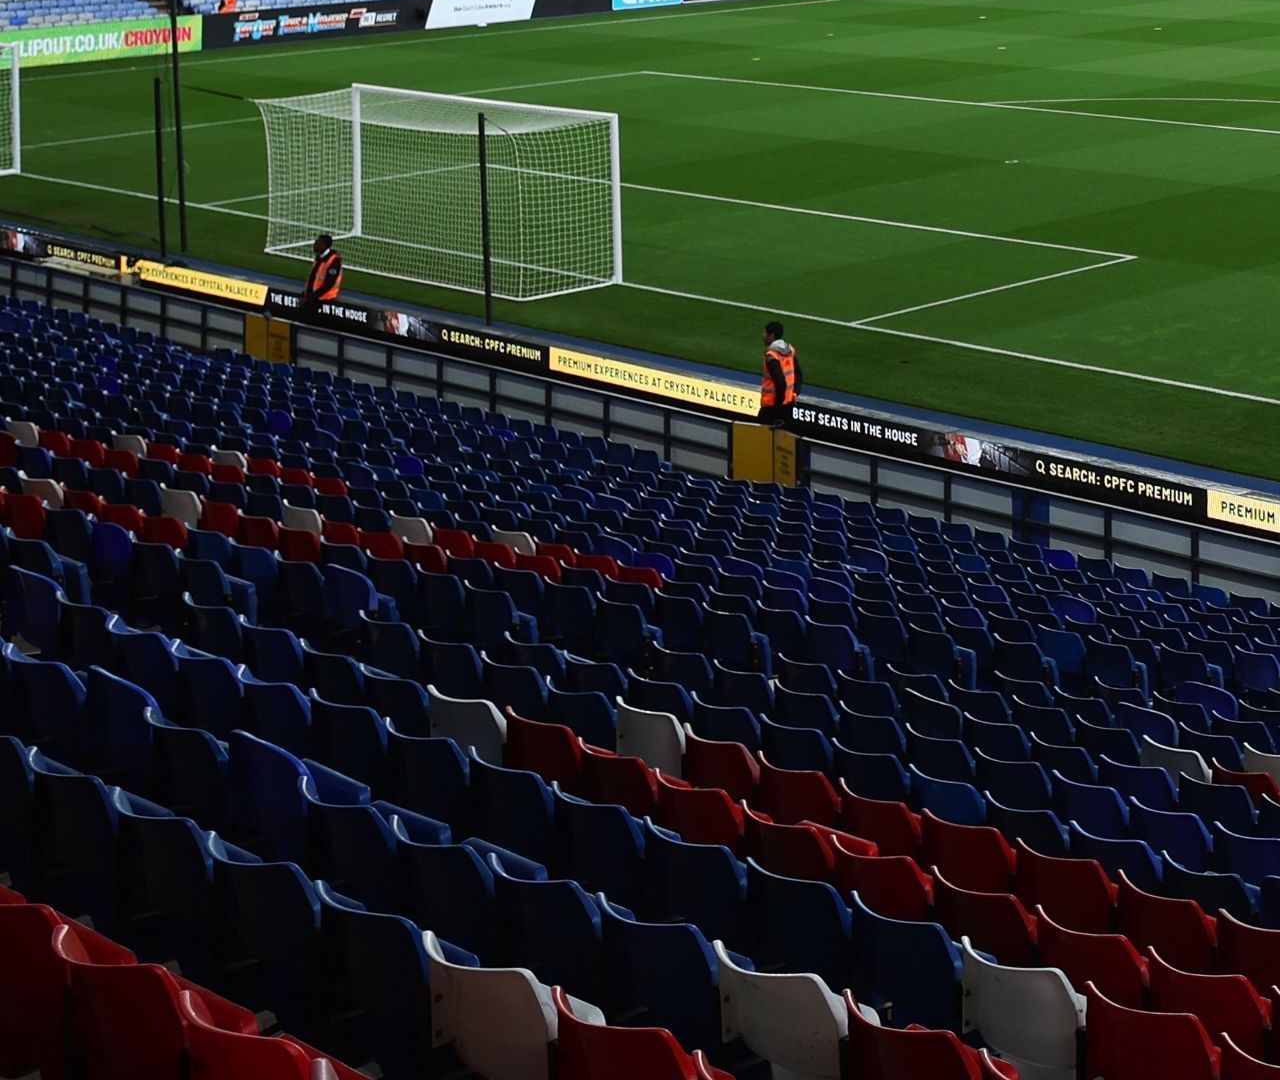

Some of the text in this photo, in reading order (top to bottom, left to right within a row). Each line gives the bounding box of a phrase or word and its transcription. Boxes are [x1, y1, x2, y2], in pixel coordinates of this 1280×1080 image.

[53, 246, 76, 260] SEARCH:
[77, 253, 91, 264] CPFC
[91, 254, 116, 269] PREMIUM
[151, 269, 189, 285] EXPERIENCES
[190, 276, 199, 286] AT
[199, 278, 225, 293] CRYSTAL
[225, 284, 249, 297] PALACE
[270, 292, 283, 305] THE
[323, 304, 368, 323] IN THE HOUSE
[450, 332, 542, 362] SEARCH: CPFC PREMIUM
[557, 355, 757, 409] PREMIUM EXPERIENCES AT CRYSTAL PALACE F.C.
[792, 407, 918, 446] BEST SEATS IN THE HOUSE
[1049, 463, 1193, 506] SEARCH: CPFC PREMIUM
[1220, 501, 1276, 525] PREMIUM
